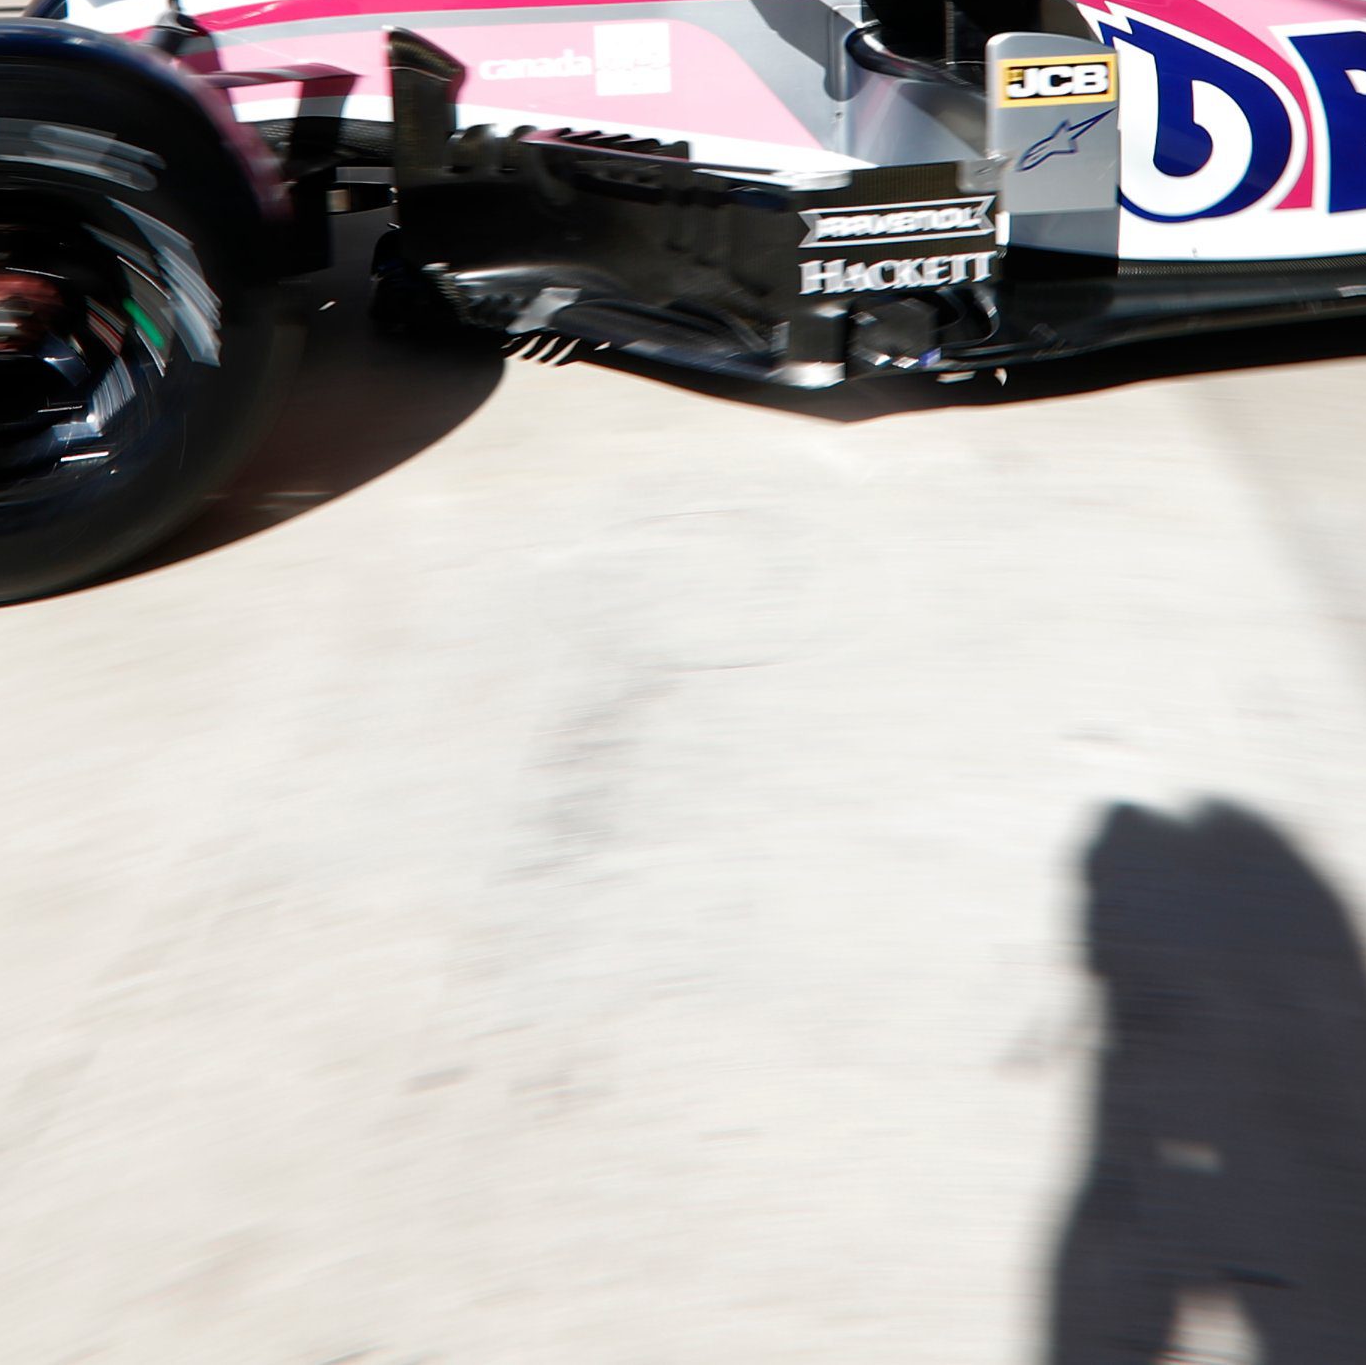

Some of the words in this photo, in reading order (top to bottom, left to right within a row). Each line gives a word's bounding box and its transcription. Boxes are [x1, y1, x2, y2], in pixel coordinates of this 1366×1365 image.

[479, 48, 592, 80] canada
[1007, 64, 1109, 99] JCB
[798, 251, 997, 296] HACKETT
